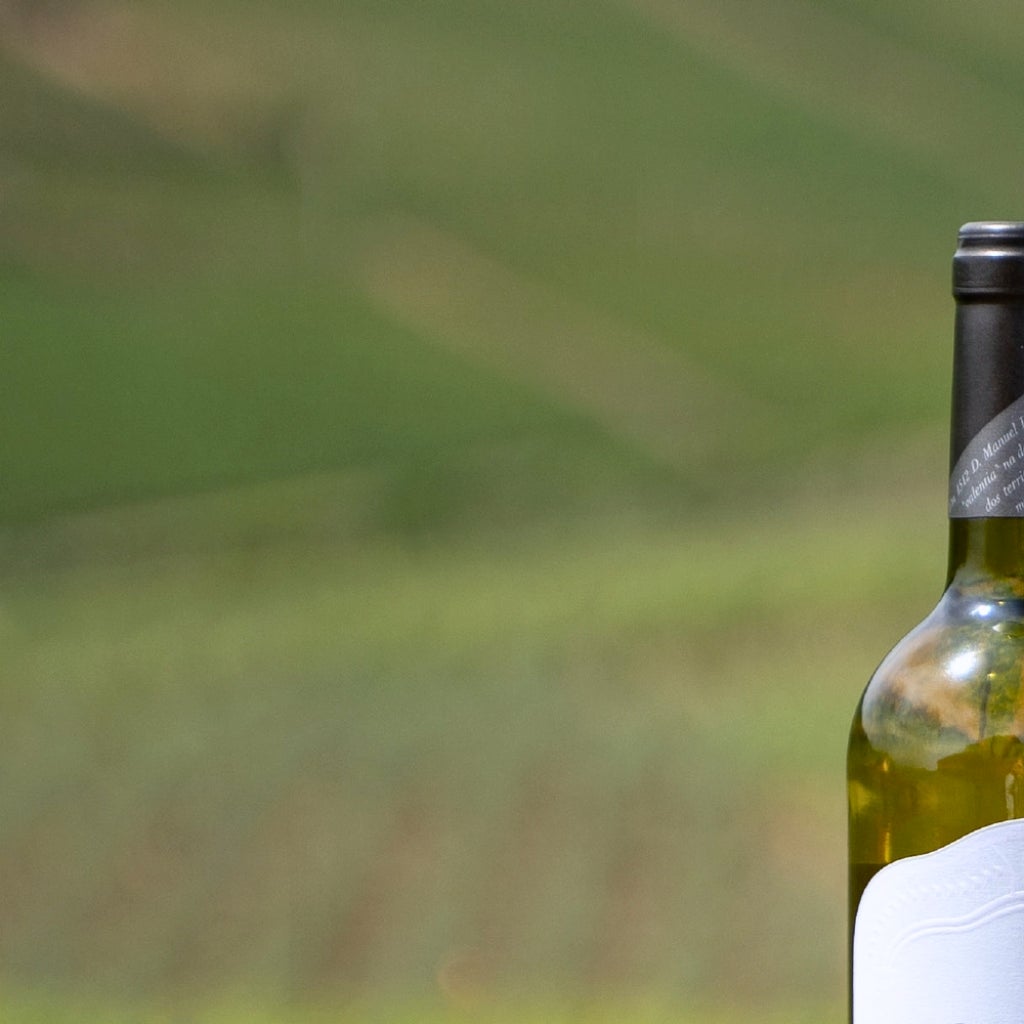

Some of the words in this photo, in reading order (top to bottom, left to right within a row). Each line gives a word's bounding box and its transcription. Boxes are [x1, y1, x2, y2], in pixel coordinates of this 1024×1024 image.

[971, 458, 982, 474] D.
[983, 422, 1018, 461] Manuel
[1002, 455, 1017, 470] na
[985, 493, 1001, 512] dos
